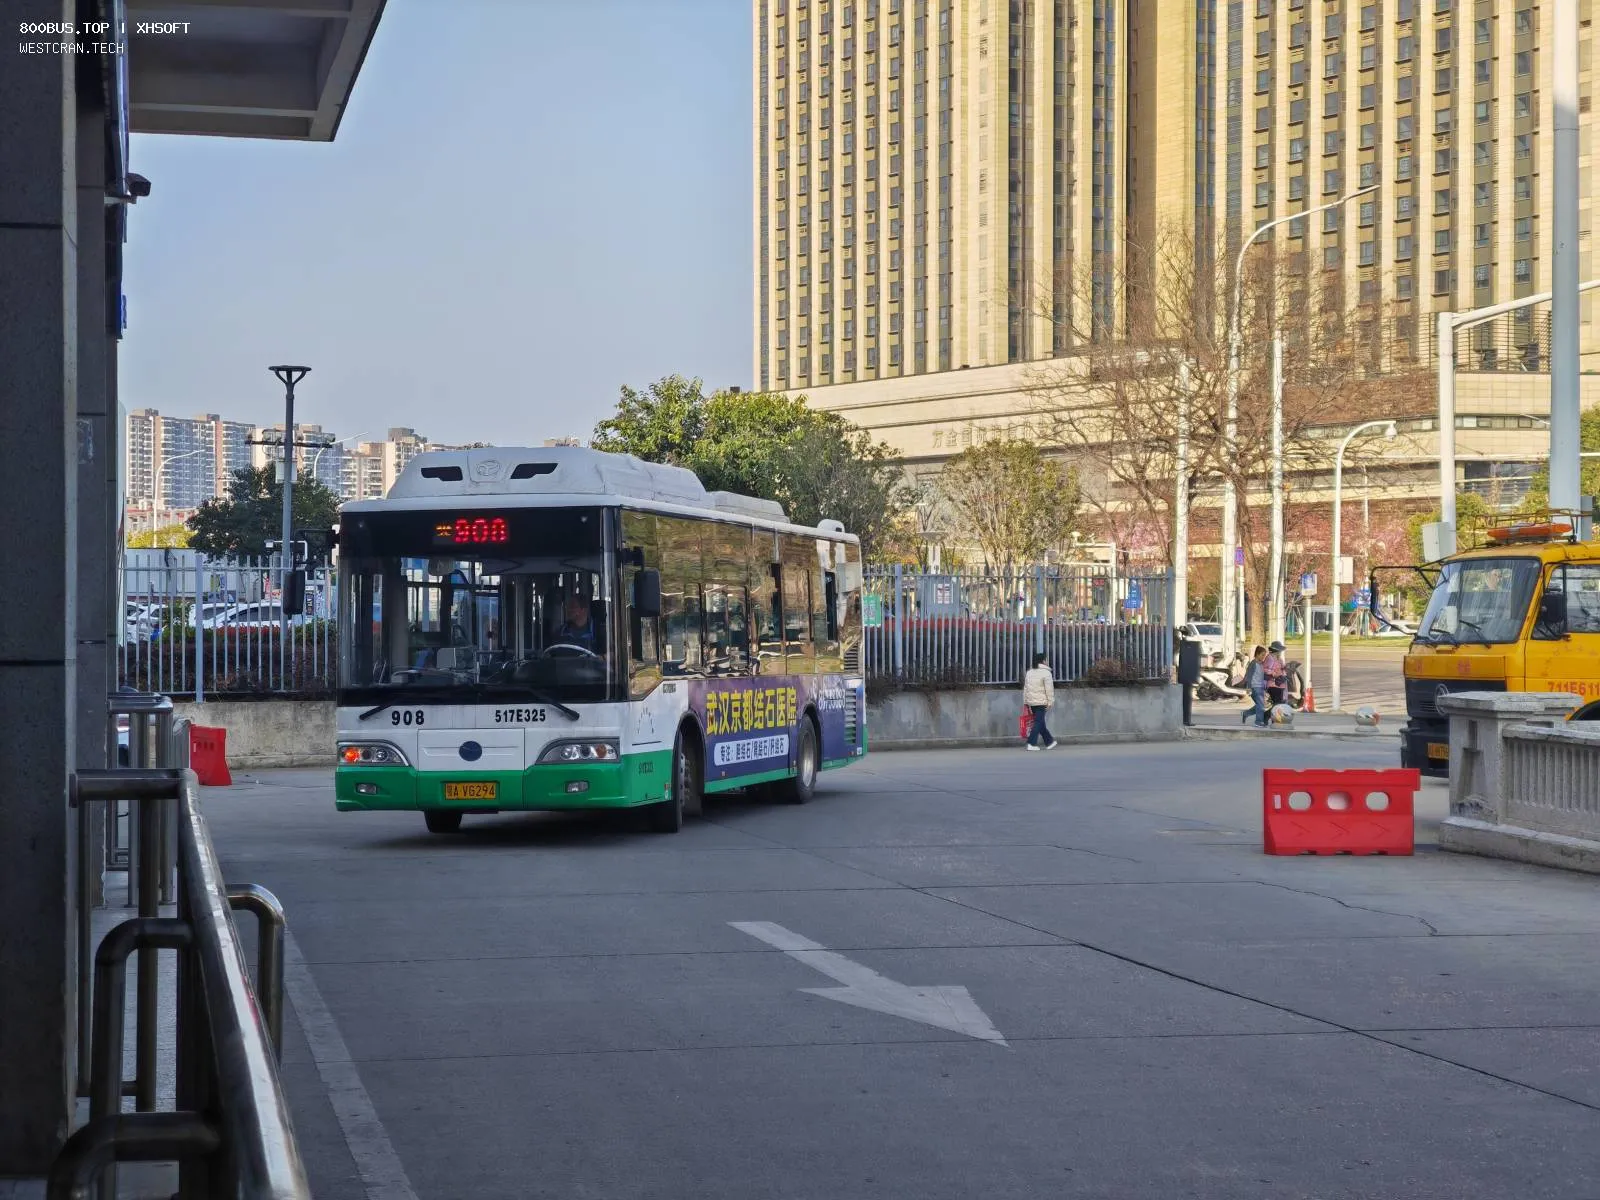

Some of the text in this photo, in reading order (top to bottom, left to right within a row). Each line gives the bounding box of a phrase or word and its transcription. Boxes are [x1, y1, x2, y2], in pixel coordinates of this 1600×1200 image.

[391, 710, 425, 726] 908
[495, 708, 546, 723] 517E325
[462, 784, 495, 797] VG294
